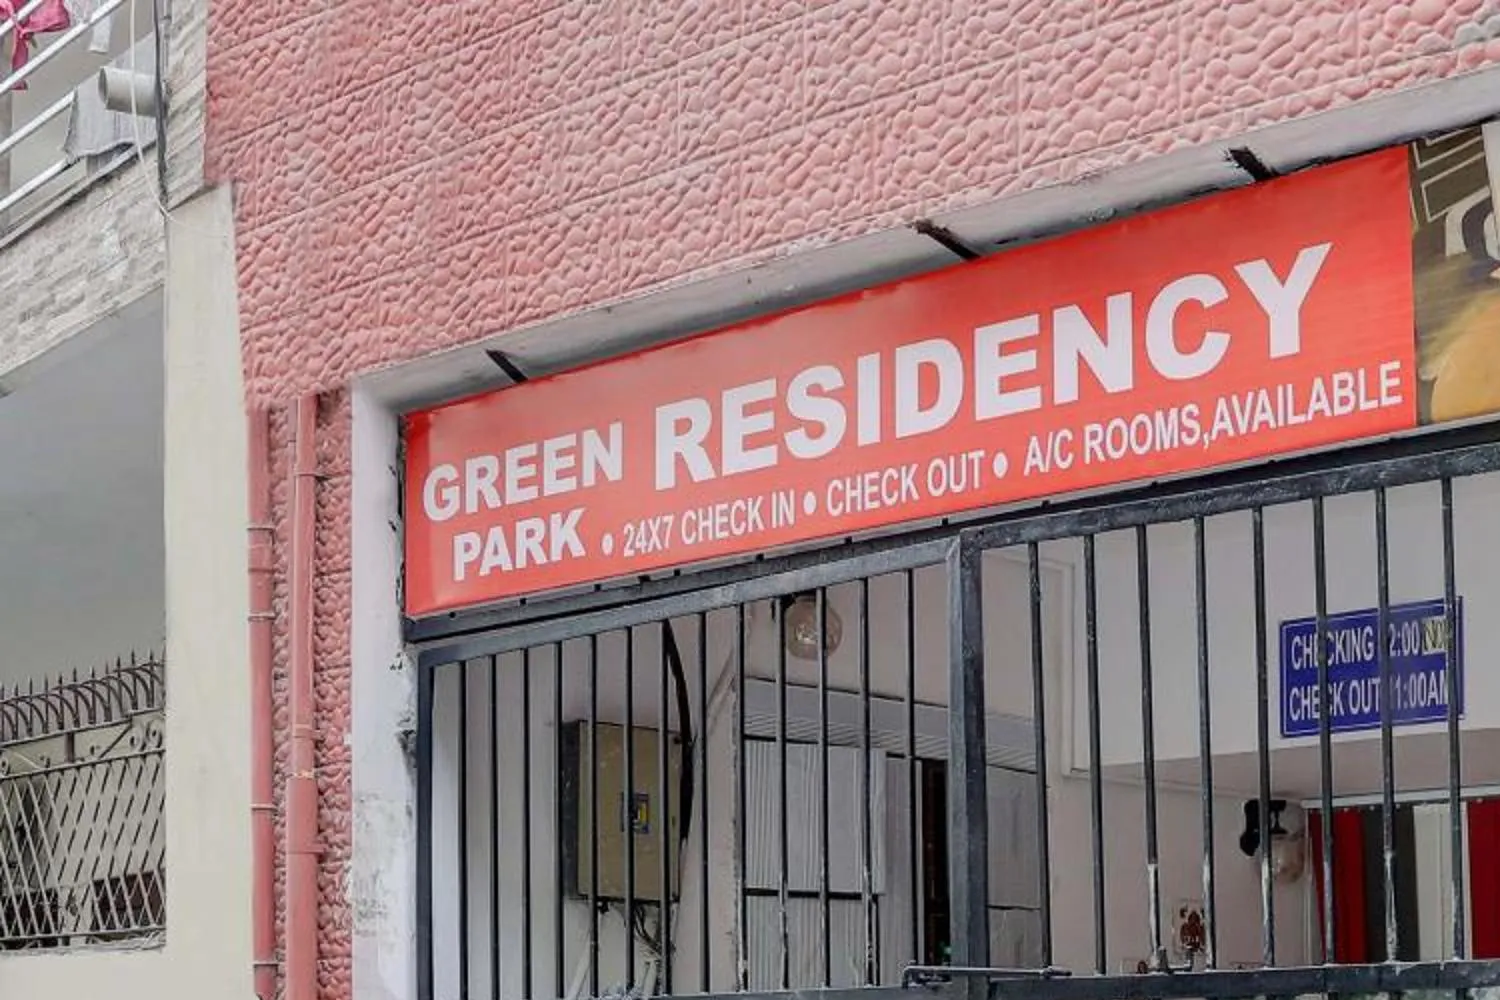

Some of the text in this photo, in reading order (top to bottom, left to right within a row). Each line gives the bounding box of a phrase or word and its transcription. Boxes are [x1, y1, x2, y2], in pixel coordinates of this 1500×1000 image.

[654, 242, 1333, 492] RESIDENCY
[422, 421, 624, 522] GREEN
[622, 515, 673, 559] 24X7
[680, 496, 765, 547] CHECK
[771, 490, 796, 527] IN
[826, 464, 919, 518] CHECK
[926, 449, 985, 499] OUT
[1023, 428, 1074, 477] A/C
[452, 507, 588, 582] PARK
[1386, 619, 1420, 657] 2:00
[1349, 678, 1381, 713] OUT
